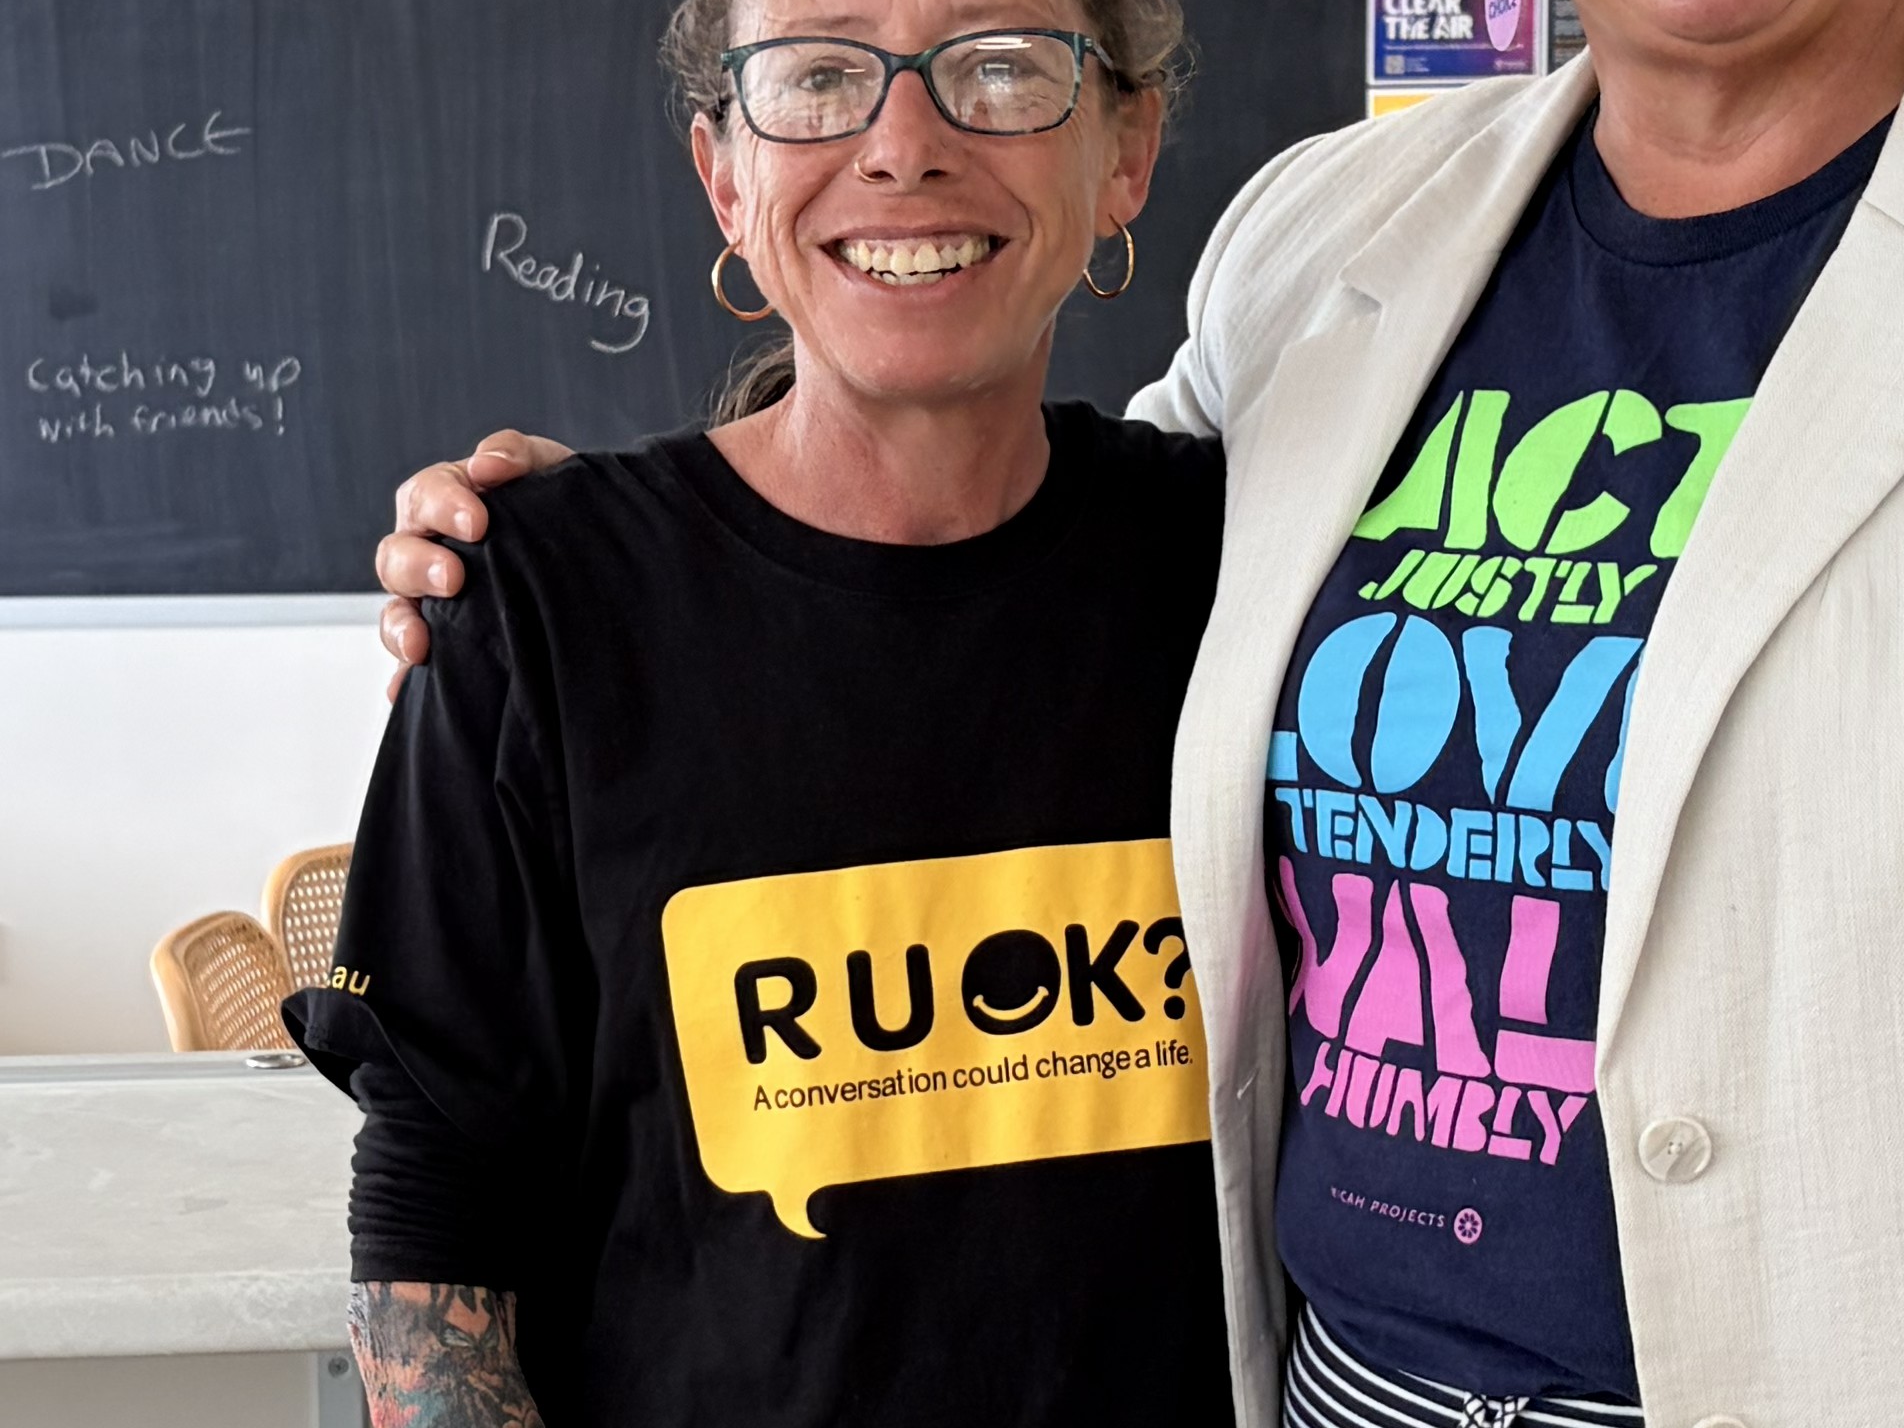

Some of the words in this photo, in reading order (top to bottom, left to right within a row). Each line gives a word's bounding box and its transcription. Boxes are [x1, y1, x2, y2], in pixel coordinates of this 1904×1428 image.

[1382, 15, 1430, 40] THE
[1432, 14, 1474, 40] AIR
[0, 111, 251, 190] DANCE
[482, 212, 650, 353] Reading
[244, 356, 302, 393] up
[38, 403, 115, 444] with
[133, 396, 285, 437] friends!
[1352, 388, 1755, 559] ACT
[1357, 548, 1659, 624] JUSTLY
[1266, 610, 1646, 813] OV
[733, 955, 823, 1065] R
[845, 942, 935, 1053] U
[754, 1084, 773, 1112] A
[774, 1068, 948, 1108] conversation
[953, 1054, 1029, 1087] could
[1035, 1049, 1132, 1079] change
[1134, 1046, 1152, 1068] a
[1154, 1038, 1194, 1067] life.
[1300, 1041, 1588, 1166] HUMBLY
[1370, 1200, 1446, 1228] PROJECTS
